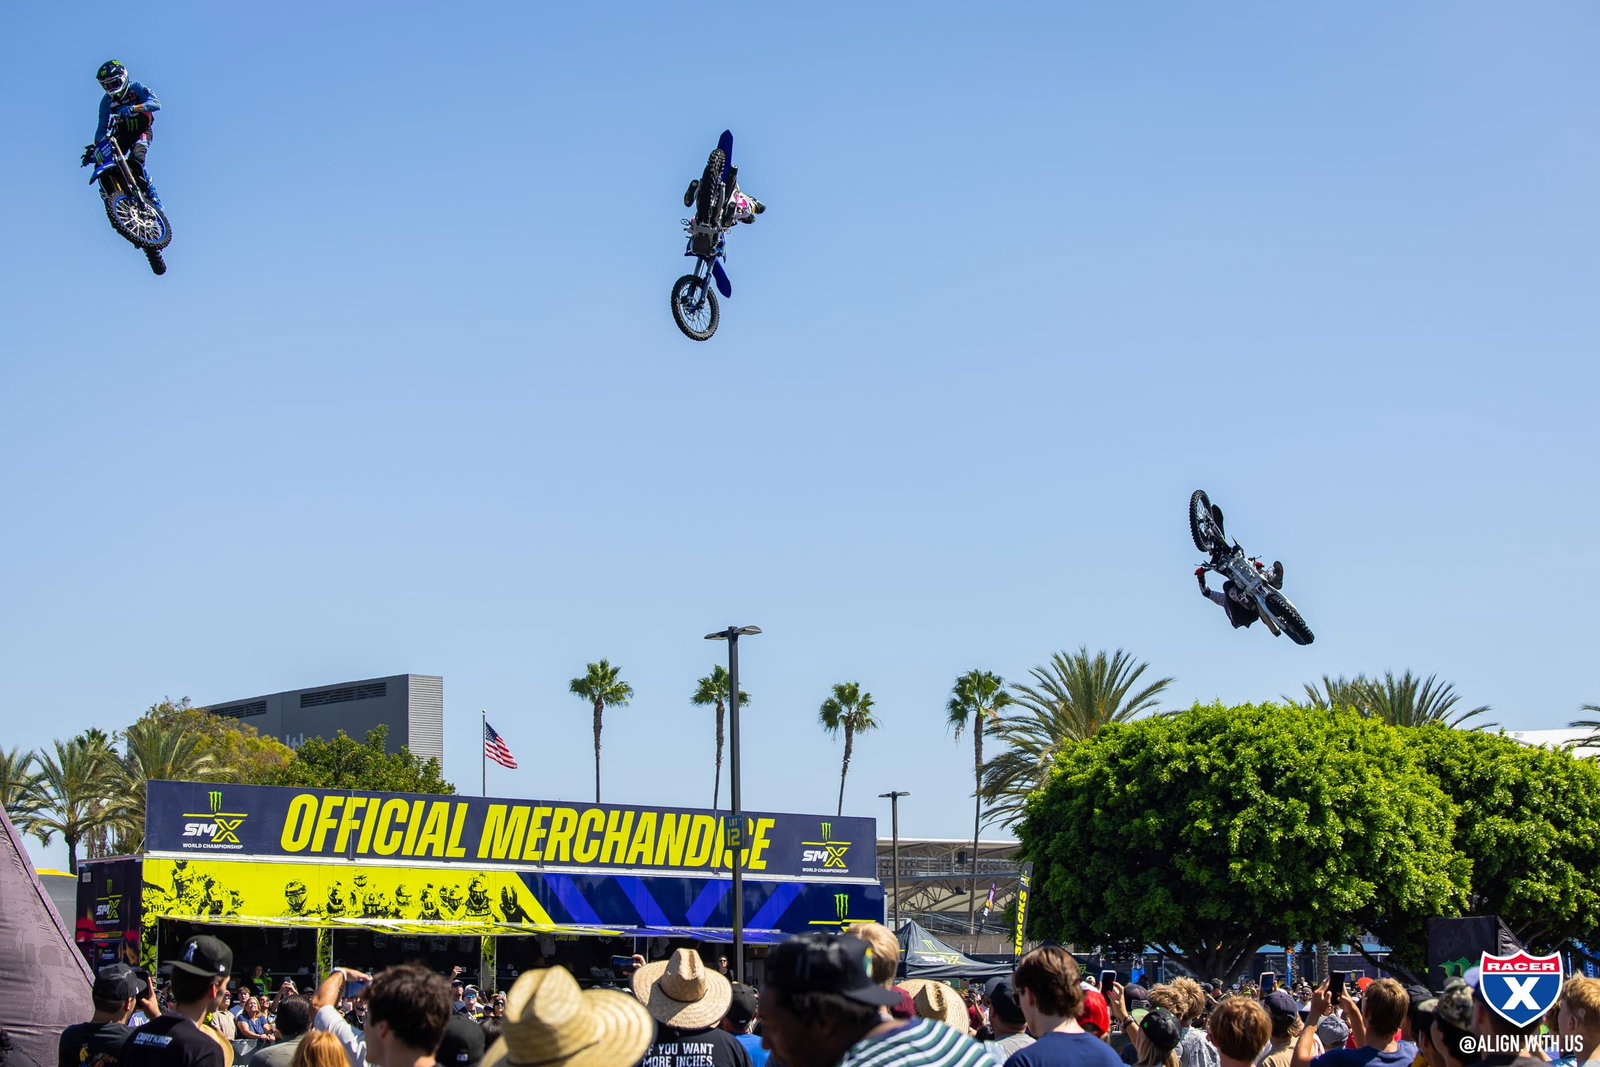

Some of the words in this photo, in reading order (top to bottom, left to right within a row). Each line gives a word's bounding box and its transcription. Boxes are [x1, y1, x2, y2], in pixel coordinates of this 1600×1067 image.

[182, 818, 245, 843] SMX
[280, 793, 469, 858] OFFICIAL
[727, 828, 741, 847] 12
[802, 846, 849, 868] SMX
[96, 900, 121, 919] SMX
[1014, 890, 1027, 956] SNACKS
[658, 1043, 678, 1055] YOU
[682, 1042, 714, 1055] WANT
[642, 1056, 672, 1067] MORE
